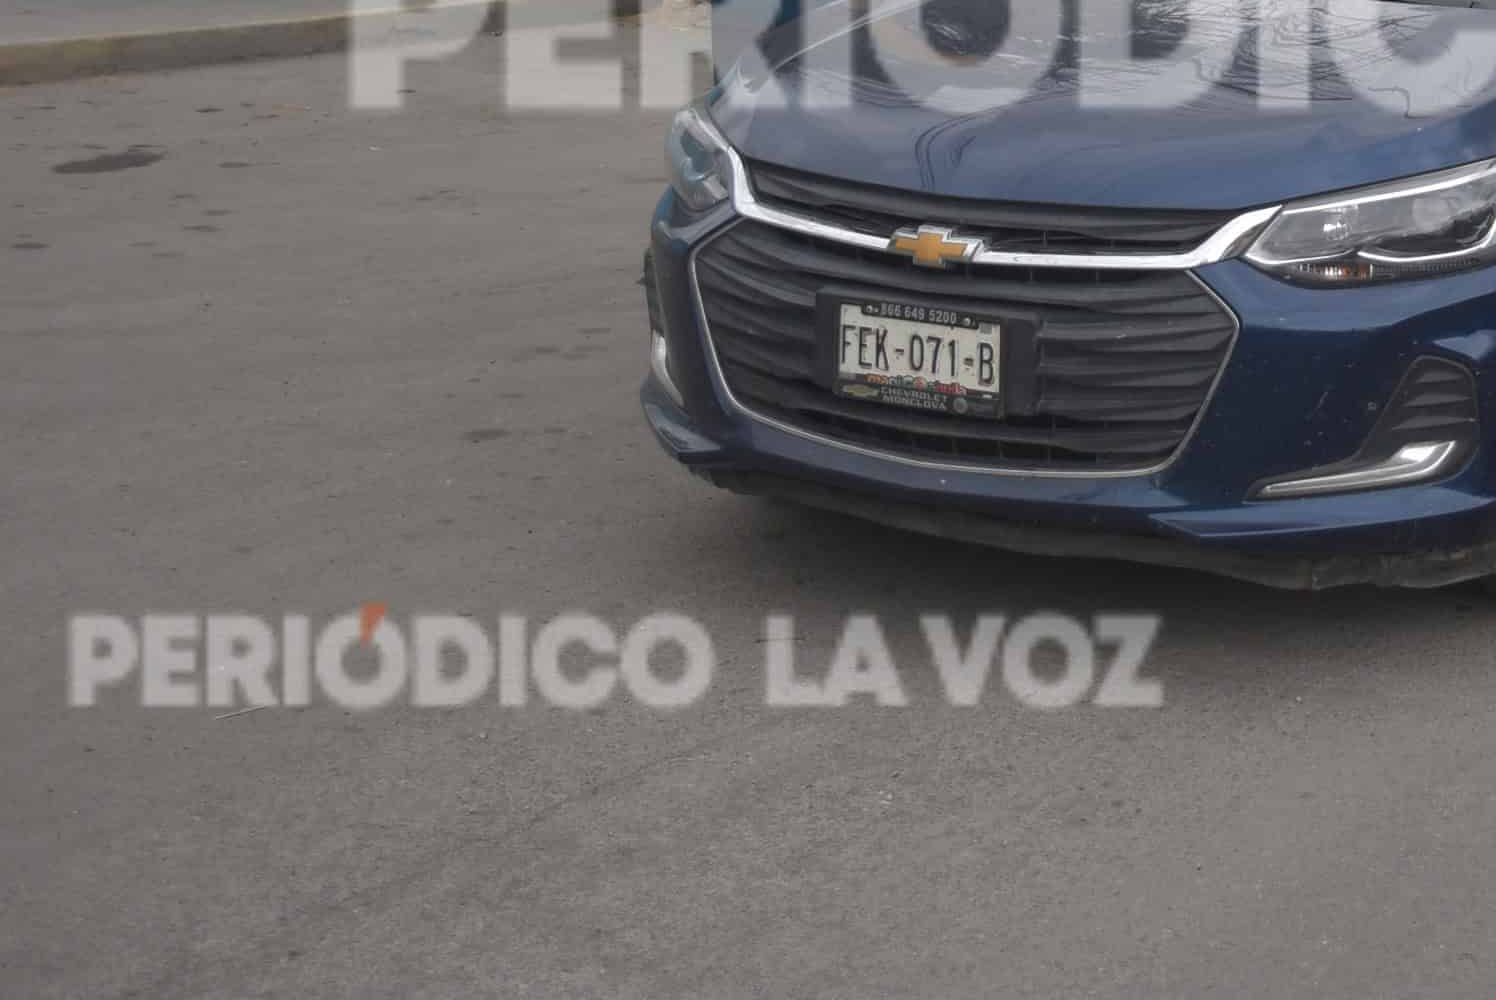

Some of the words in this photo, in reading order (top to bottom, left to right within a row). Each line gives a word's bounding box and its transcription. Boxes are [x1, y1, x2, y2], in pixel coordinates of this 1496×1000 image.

[928, 309, 957, 325] 5200
[842, 324, 995, 386] FEK-071-B
[881, 395, 949, 410] MONCLOVA
